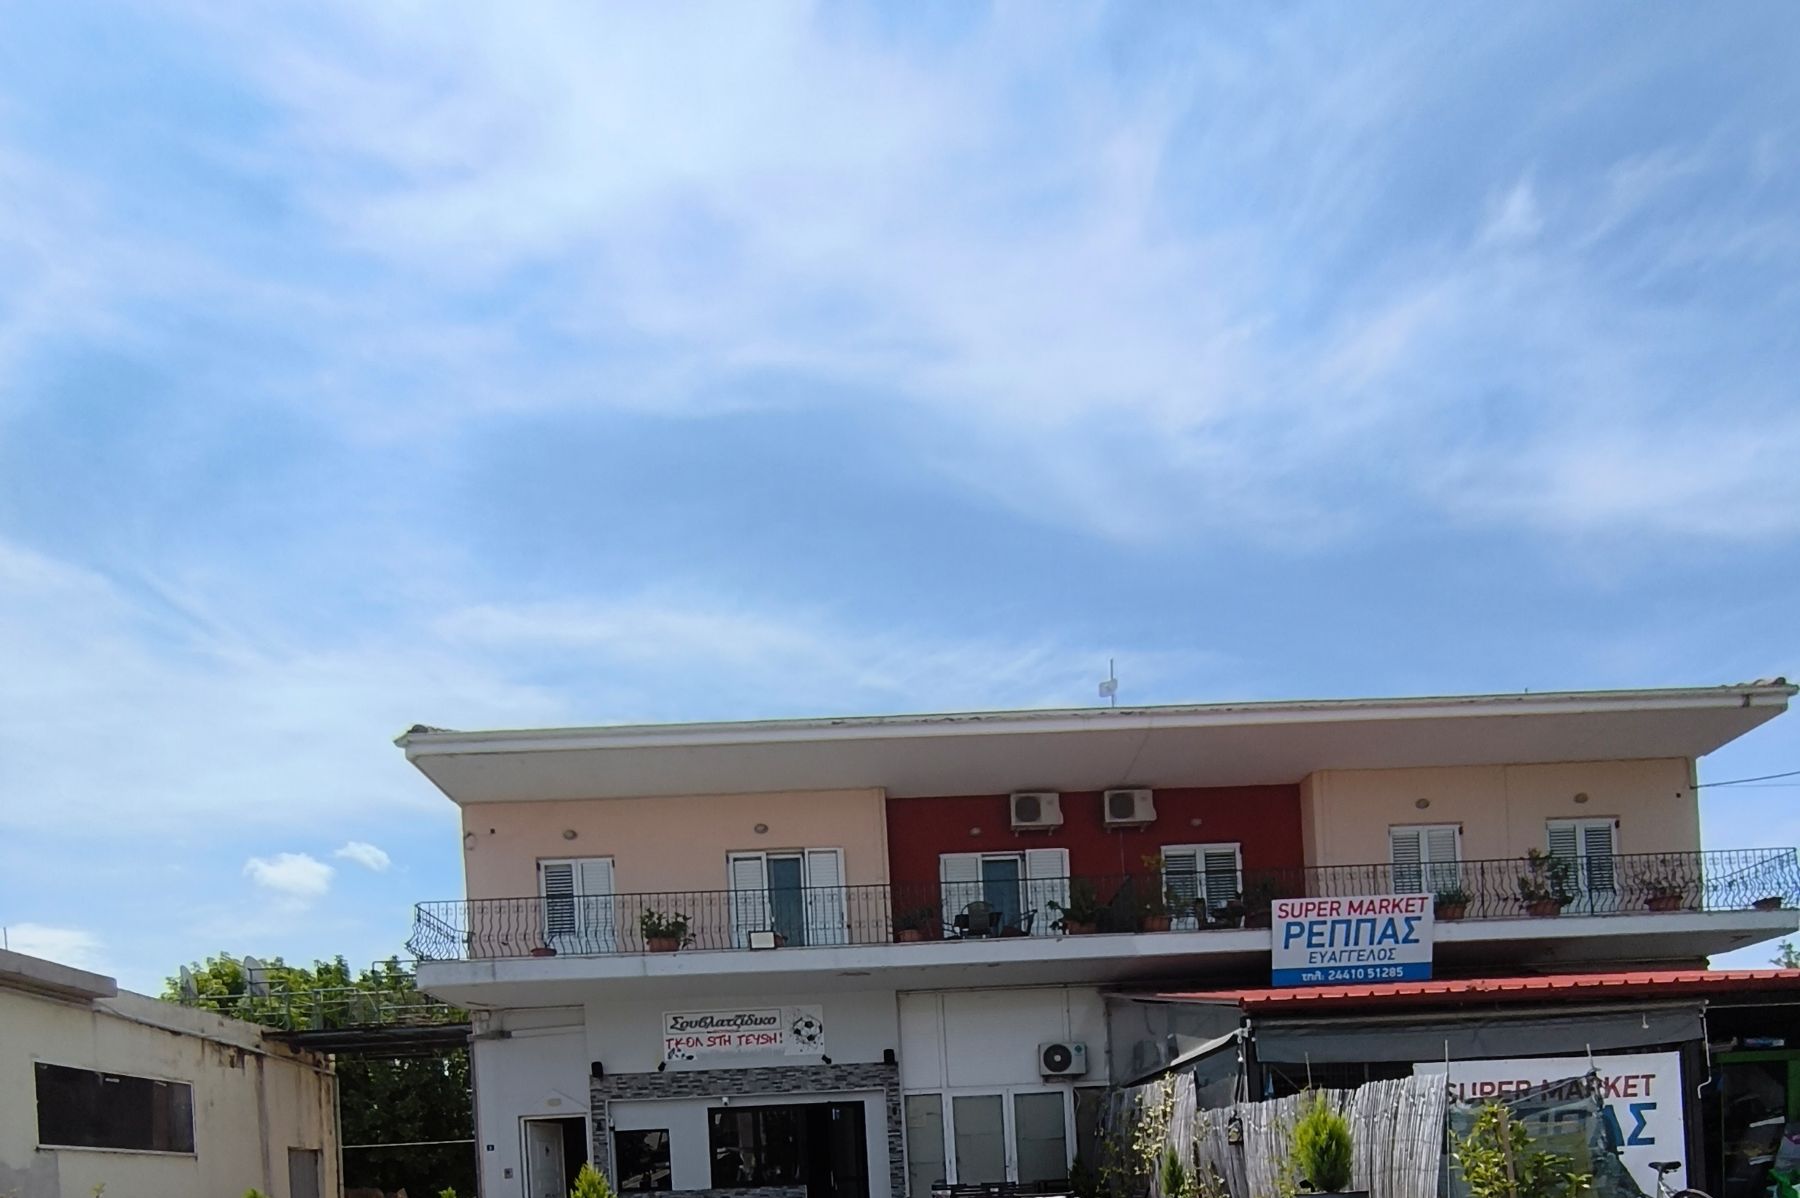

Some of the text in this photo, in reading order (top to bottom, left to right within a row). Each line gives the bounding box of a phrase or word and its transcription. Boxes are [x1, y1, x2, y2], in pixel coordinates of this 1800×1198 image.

[1278, 897, 1429, 919] SUPER MARKET
[1283, 916, 1422, 949] ΡΕΠΠΑΣ
[1308, 948, 1397, 964] ΕΥΑΓΓΕΛΟΣ
[1328, 968, 1365, 981] 24410
[1367, 966, 1404, 979] 51285
